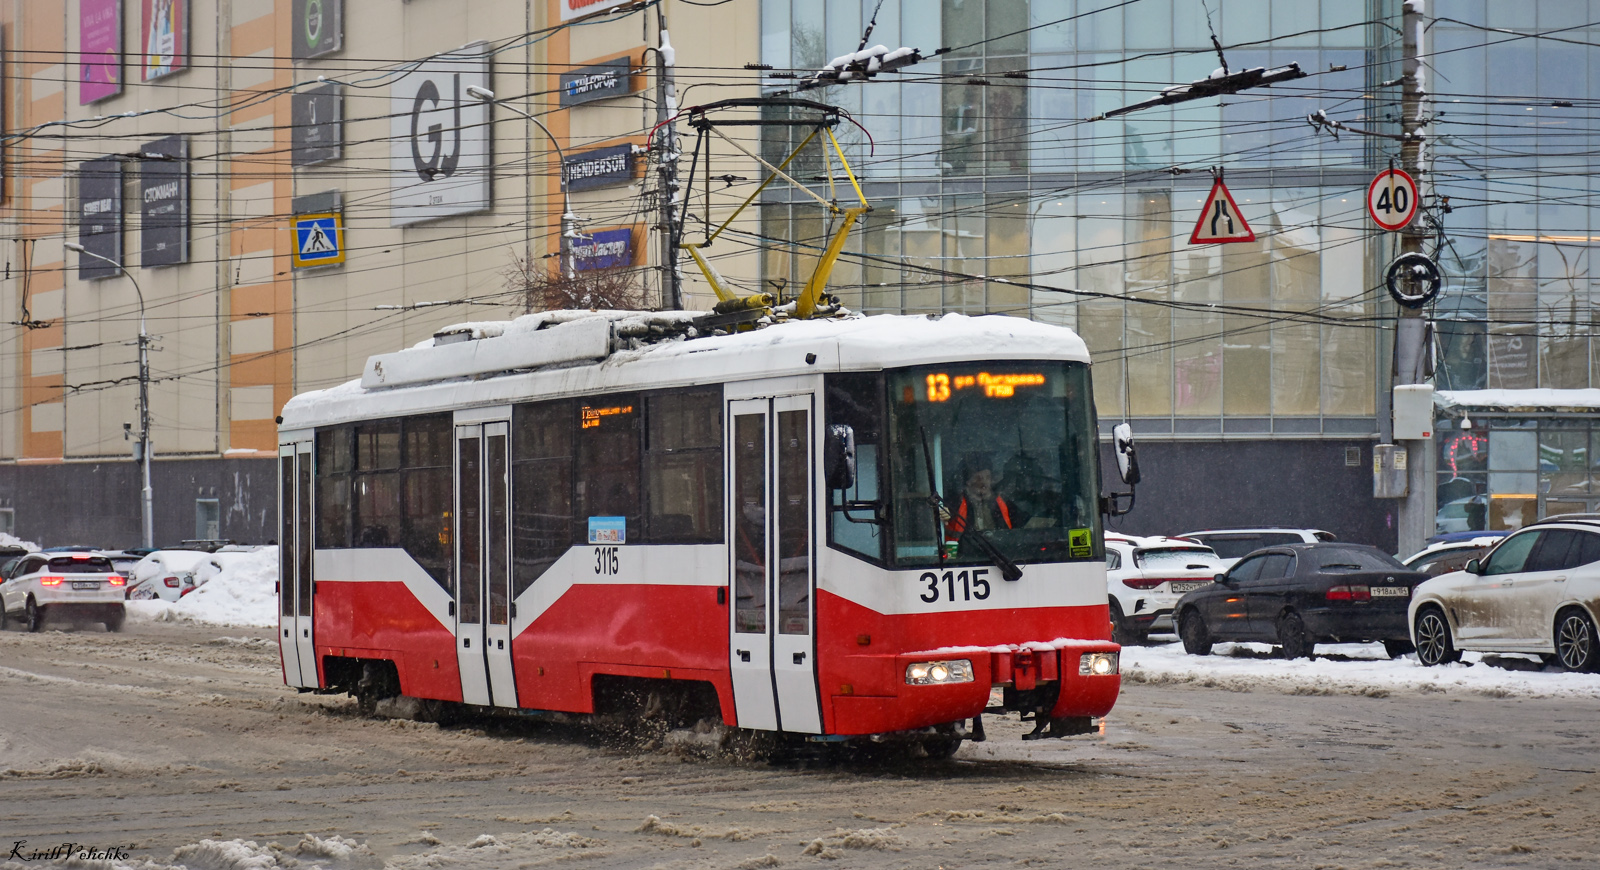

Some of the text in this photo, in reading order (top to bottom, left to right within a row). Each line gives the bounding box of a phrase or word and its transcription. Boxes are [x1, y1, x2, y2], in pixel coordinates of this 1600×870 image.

[410, 72, 461, 183] GJ
[570, 153, 626, 180] HENDERSON
[144, 181, 179, 203] СТОКМАНН
[1376, 185, 1409, 214] 40
[926, 373, 951, 402] 13
[594, 546, 619, 576] 3115
[919, 568, 991, 603] 3115
